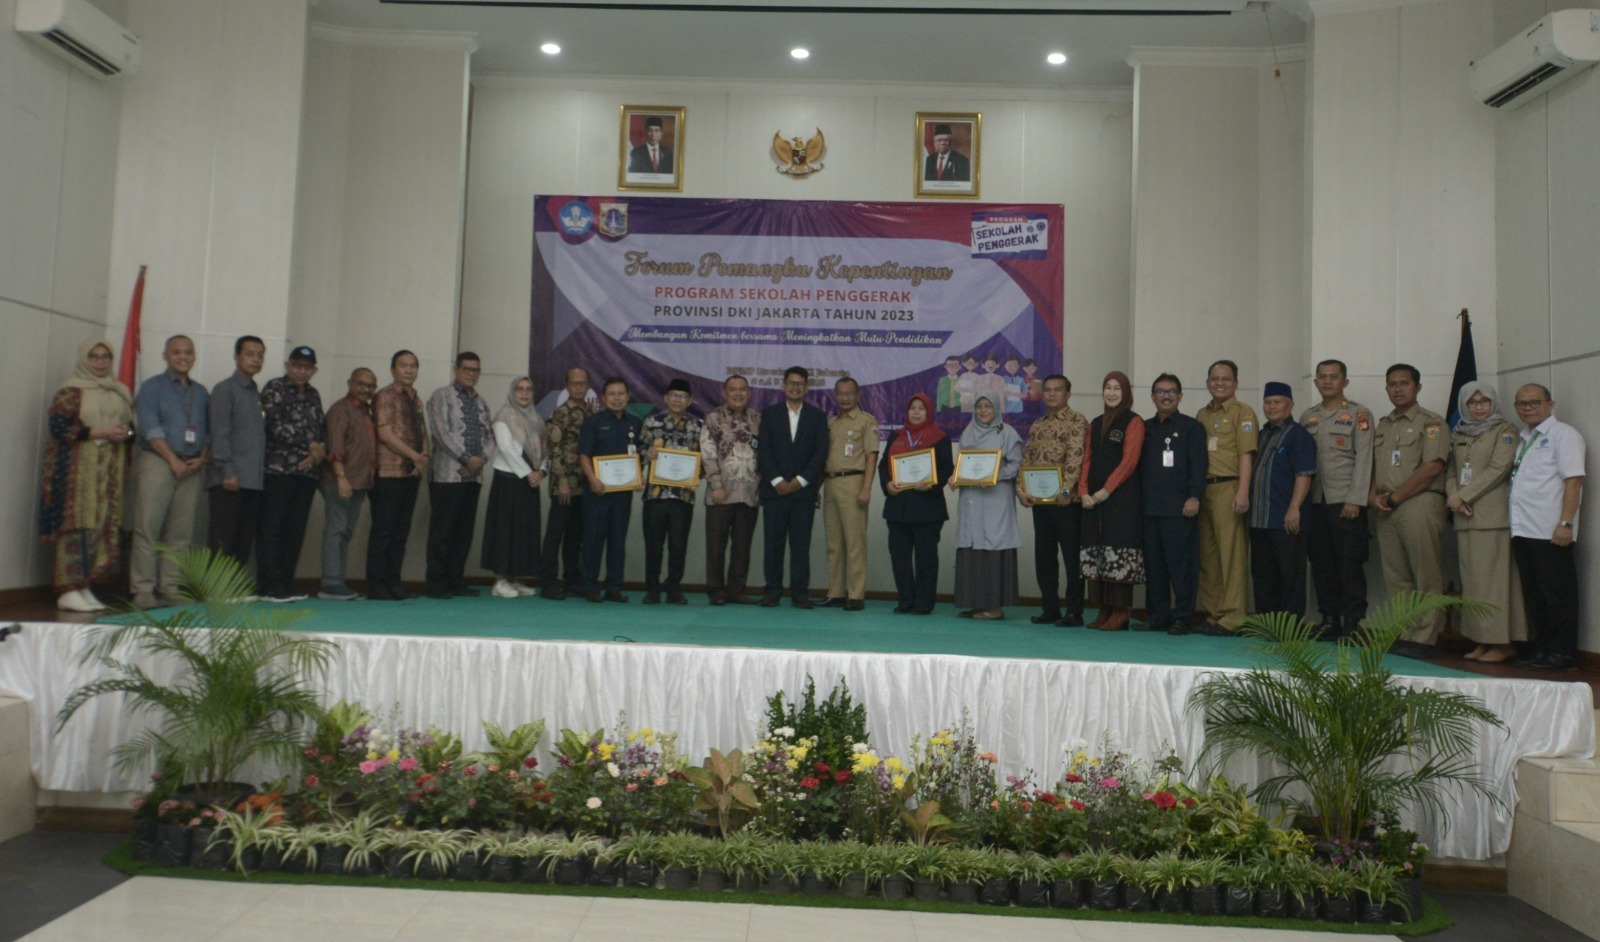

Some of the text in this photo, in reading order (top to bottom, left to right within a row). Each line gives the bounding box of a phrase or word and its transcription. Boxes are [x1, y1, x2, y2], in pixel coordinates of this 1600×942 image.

[976, 224, 1023, 240] SEKOLAH
[978, 233, 1040, 252] PENGGERAK
[624, 250, 954, 287] Forum Pemangku Kepentingan
[654, 286, 912, 303] PROGRAM SEKOLAH PENGGERAK
[653, 305, 914, 322] PROVINSI DKI JAKARTA TAHUN 2023
[628, 327, 943, 345] Membangun Komitmen bersama Meningkatkan Mutu Pendidikan
